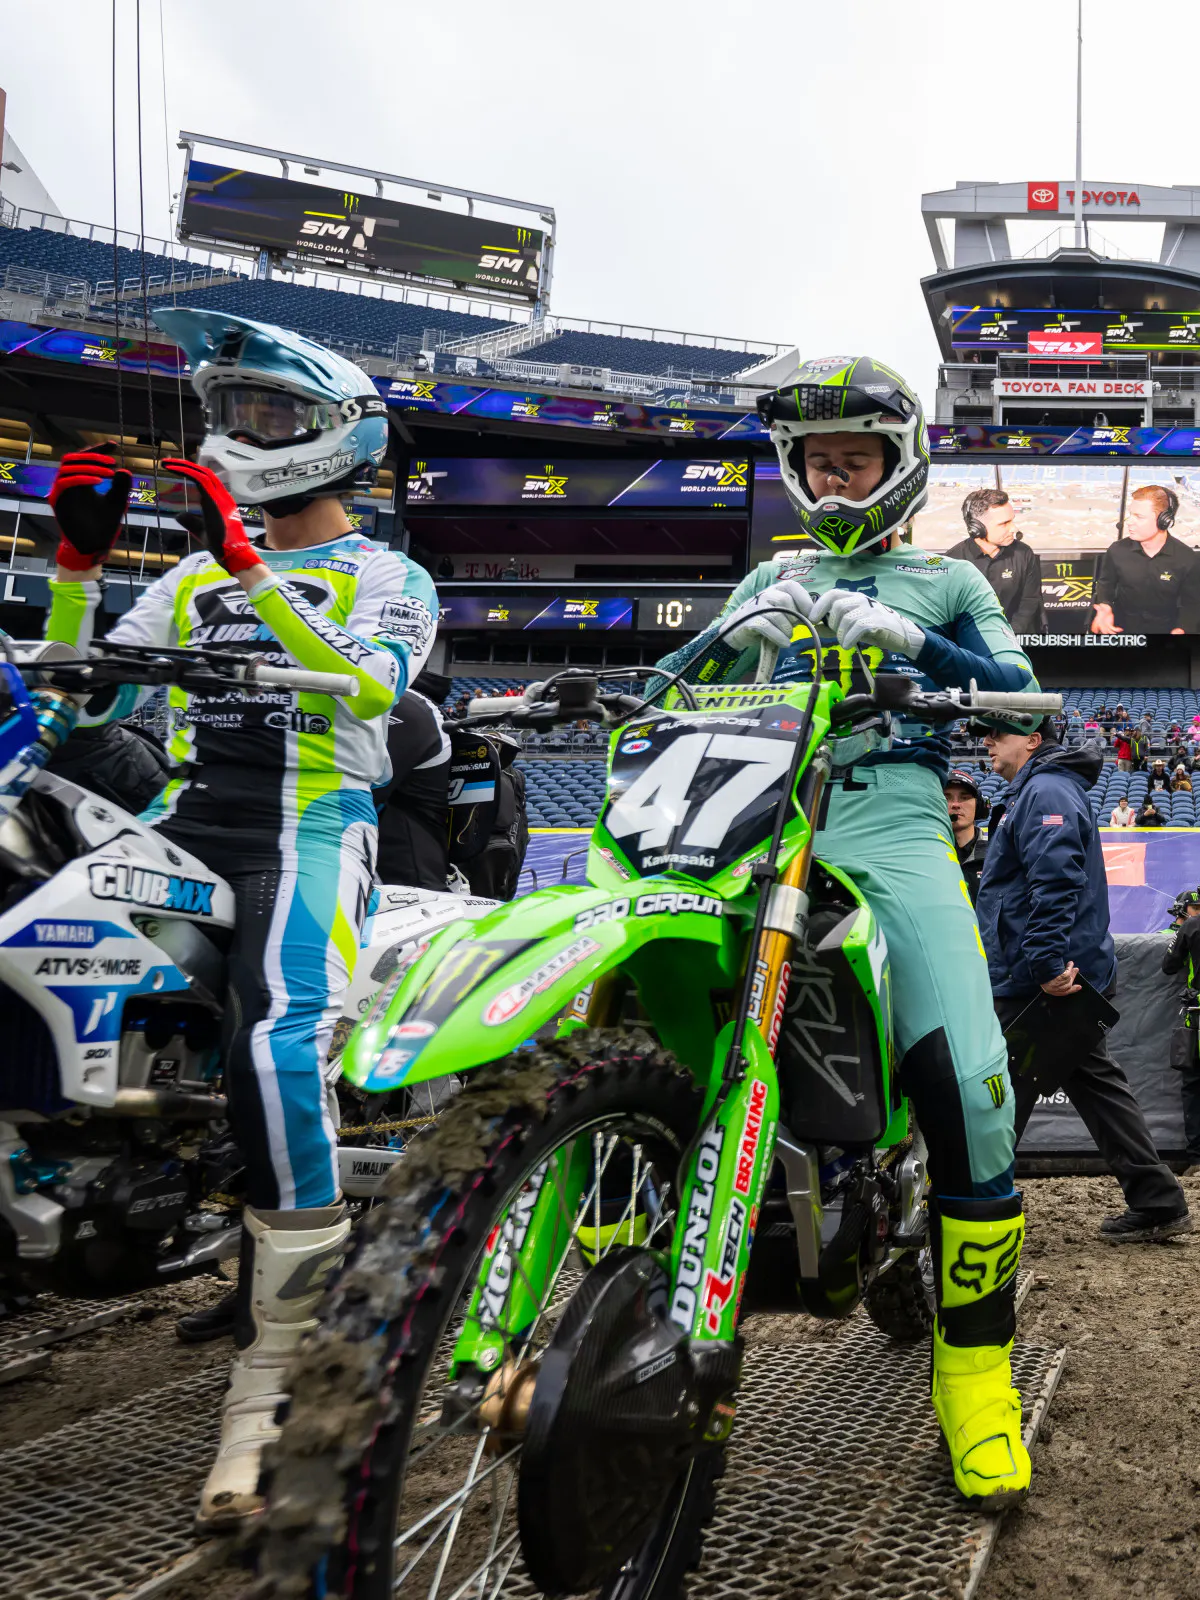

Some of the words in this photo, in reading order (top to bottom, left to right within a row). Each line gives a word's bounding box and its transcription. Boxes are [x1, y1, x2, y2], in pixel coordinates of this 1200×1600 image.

[1066, 190, 1140, 206] TOYOTA
[297, 240, 323, 251] WORLD
[475, 273, 500, 283] WORLD
[1043, 341, 1096, 353] FLY
[389, 381, 437, 398] SMX
[1002, 382, 1062, 393] TOYOTA
[1068, 382, 1096, 393] FAN
[1104, 383, 1144, 394] DECK
[1092, 428, 1130, 442] SMX
[682, 462, 748, 485] SMX
[523, 480, 566, 494] SMX
[884, 466, 926, 509] MONSTER
[896, 565, 948, 575] Kawasaki
[564, 602, 600, 614] SMX
[1085, 634, 1147, 646] ELECTRIC
[605, 733, 797, 850] 47
[642, 854, 715, 869] Kawasaki
[88, 863, 216, 916] CLUBMX
[35, 924, 94, 943] YAMAHA
[733, 1080, 768, 1196] BRAKING
